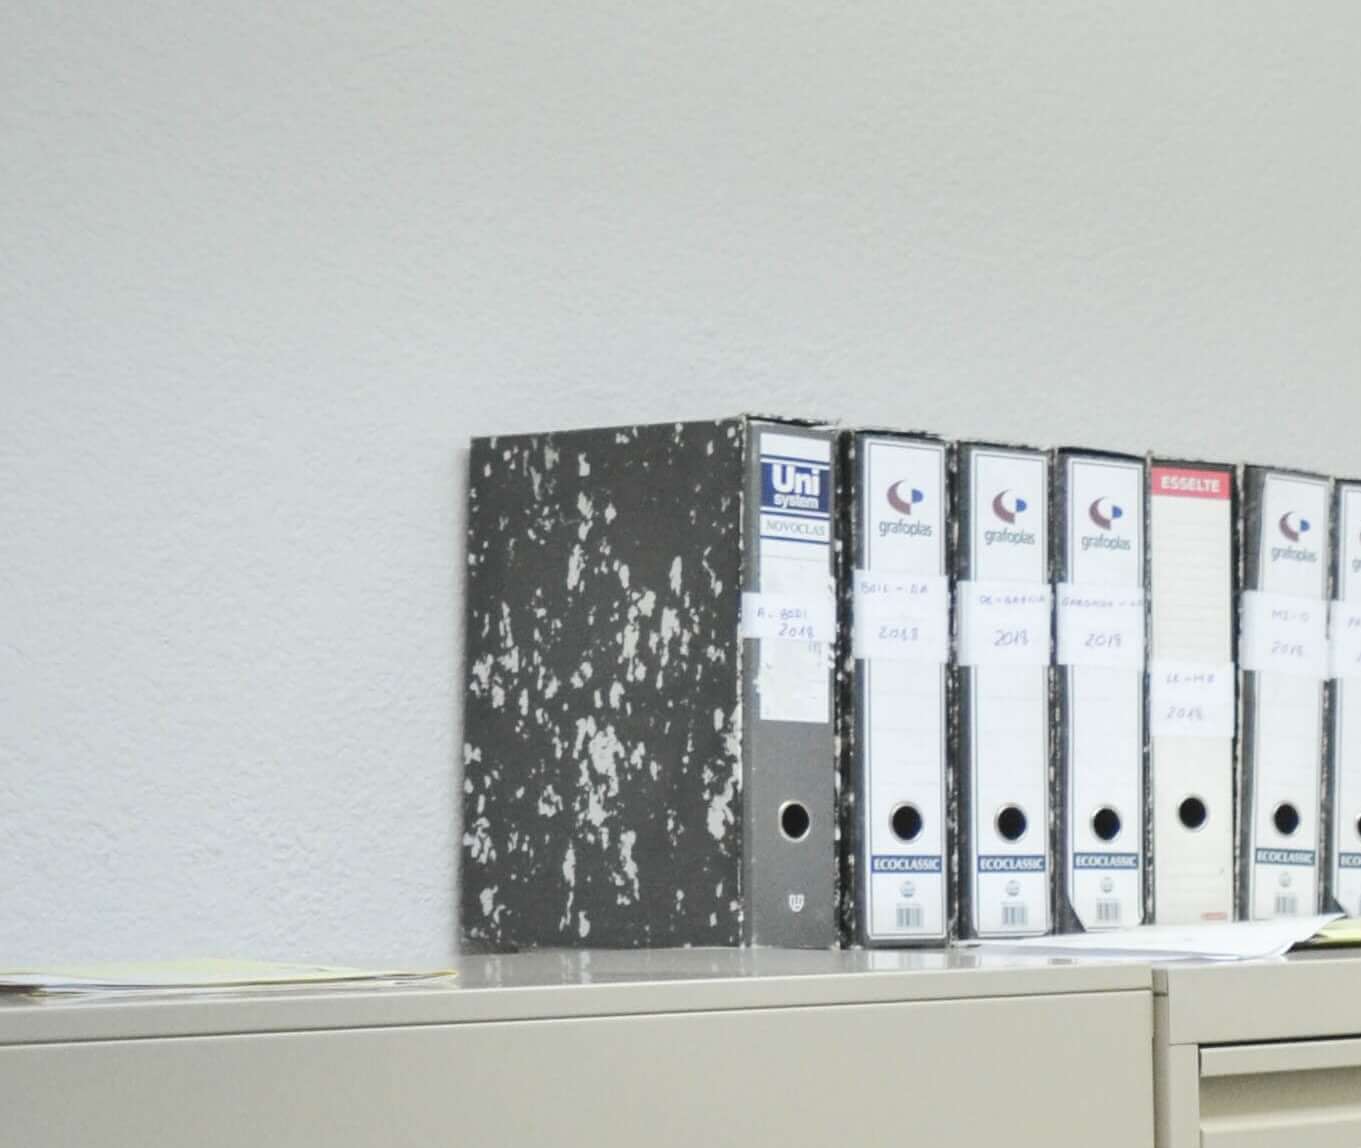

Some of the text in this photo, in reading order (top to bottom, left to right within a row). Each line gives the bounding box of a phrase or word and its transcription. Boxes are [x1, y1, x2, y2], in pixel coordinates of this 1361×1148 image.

[771, 463, 820, 496] Uni
[1160, 475, 1221, 493] ESSELTE
[774, 494, 820, 510] system
[879, 519, 933, 537] grafoplas
[984, 528, 1036, 546] grafoplas
[1081, 534, 1132, 552] grafoplas
[1271, 546, 1318, 563] grafoplas
[873, 857, 941, 872] ECOCLASSIC
[980, 857, 1045, 871] ECOCLASSIC
[1075, 855, 1138, 869] ECOCLASSIC
[1257, 850, 1315, 866] ECOCLASSIC
